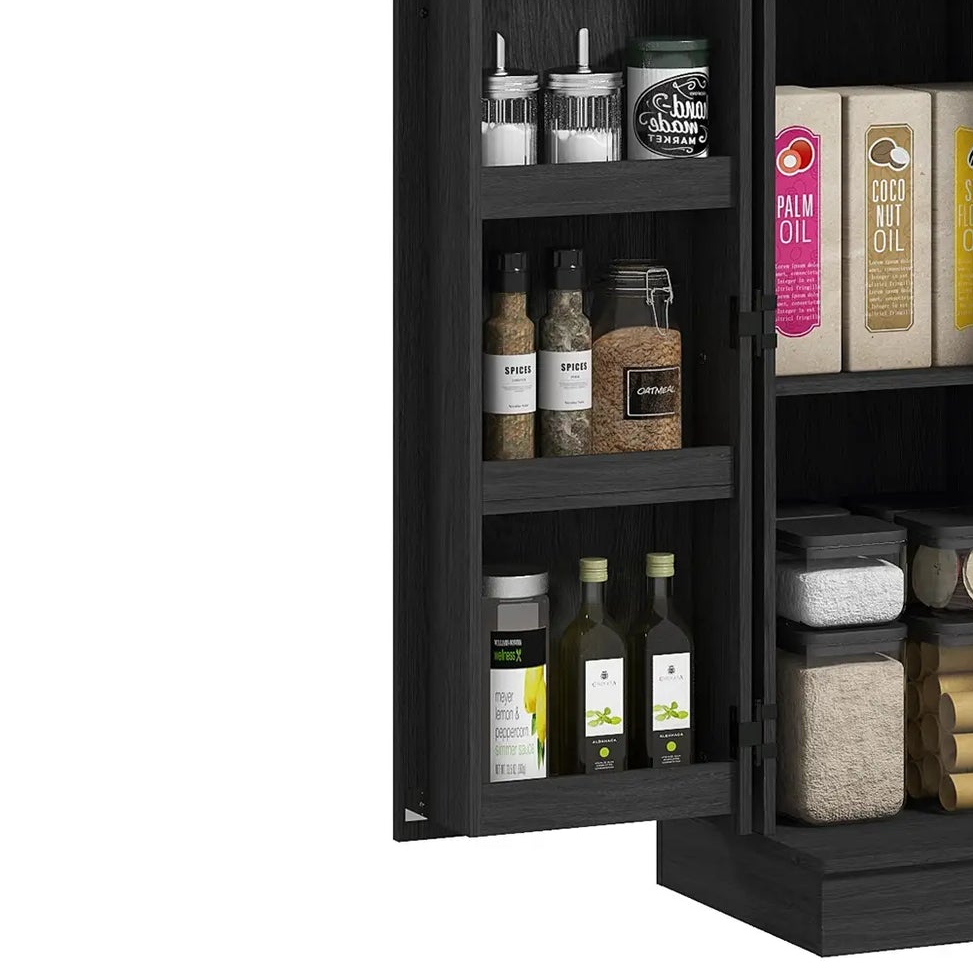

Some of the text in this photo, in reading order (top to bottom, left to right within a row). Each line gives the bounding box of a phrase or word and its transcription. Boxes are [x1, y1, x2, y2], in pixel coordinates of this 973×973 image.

[872, 178, 905, 202] COCO
[777, 194, 813, 218] PALM
[876, 204, 902, 227] NUT
[780, 219, 812, 244] OIL
[874, 229, 905, 253] OIL
[504, 365, 532, 375] SPICES
[561, 362, 588, 372] SPICES
[636, 385, 676, 395] OATMEAL
[495, 691, 514, 706] meyer
[495, 706, 520, 720] lemon &
